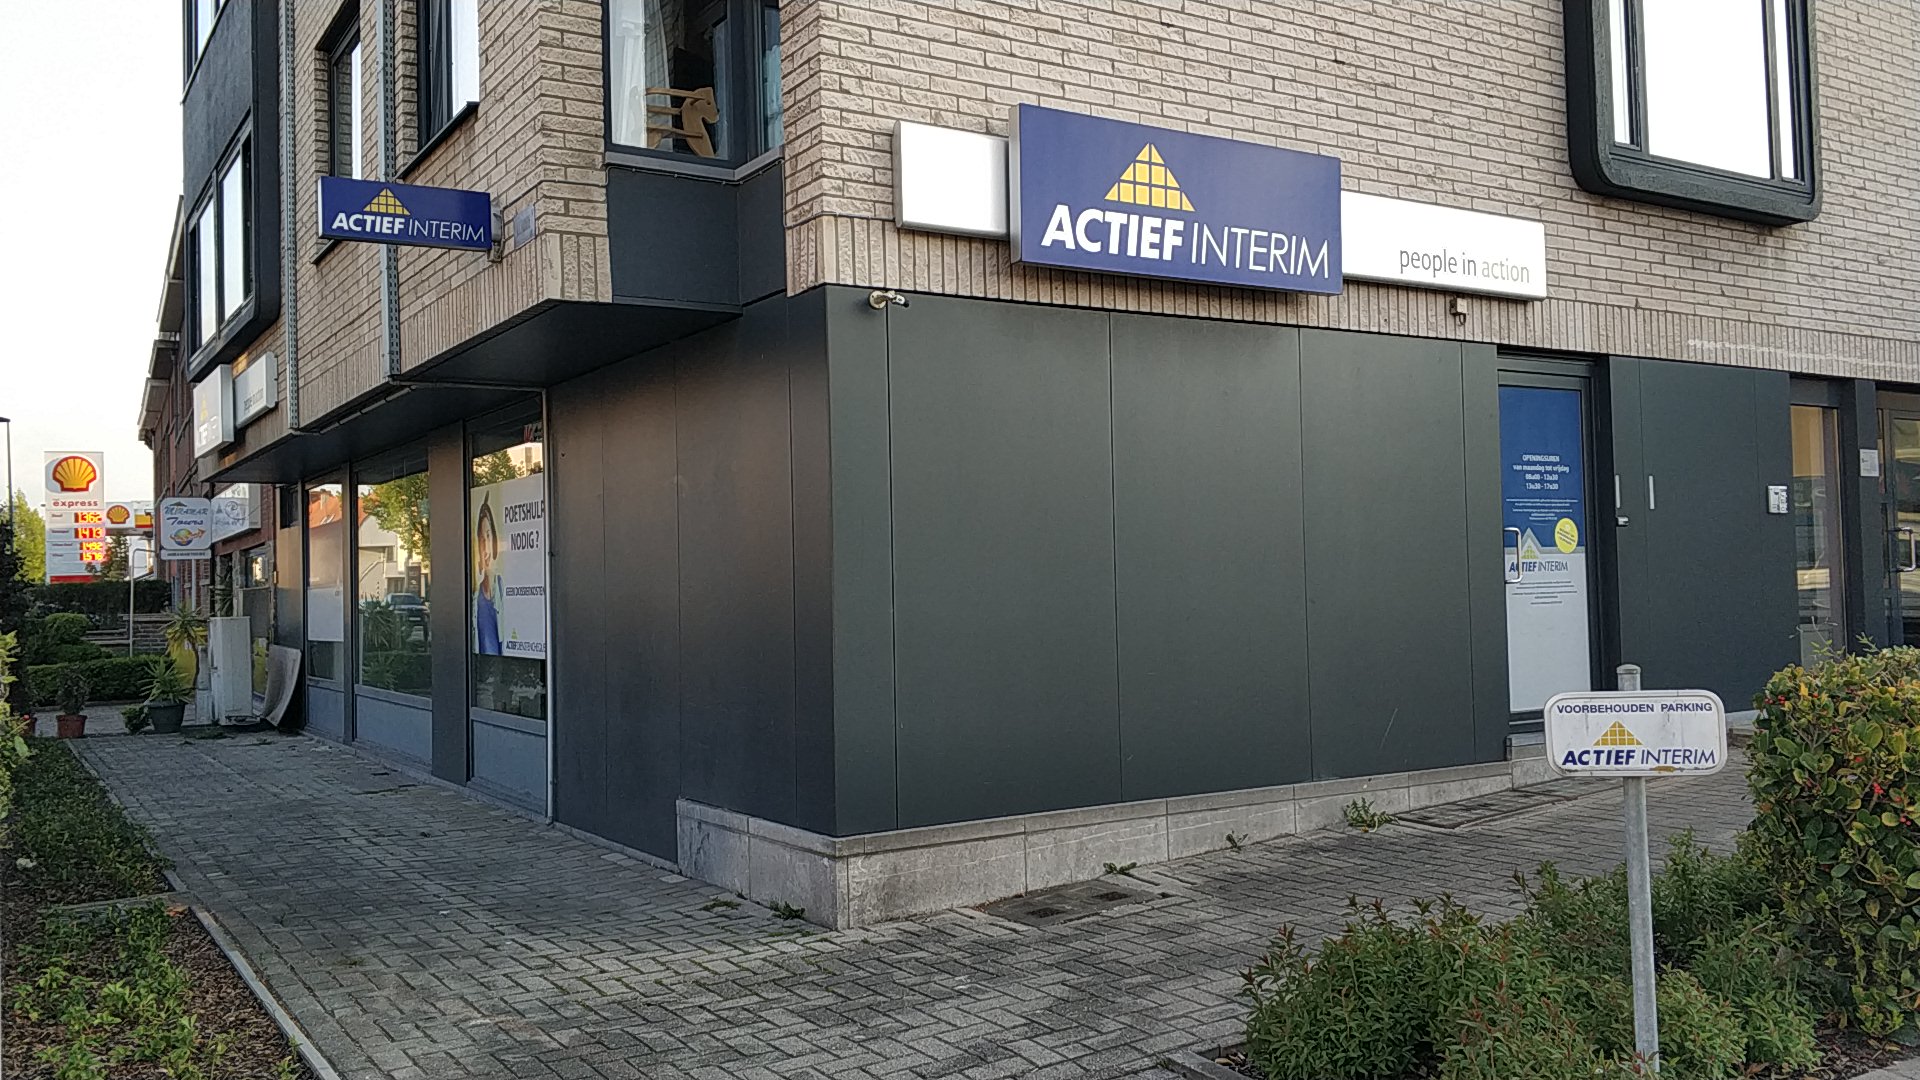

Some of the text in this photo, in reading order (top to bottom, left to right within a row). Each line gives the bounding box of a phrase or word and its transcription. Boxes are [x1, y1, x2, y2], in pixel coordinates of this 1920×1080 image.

[331, 212, 485, 242] ACTIEF INTERIM
[1040, 203, 1329, 279] ACTIEF INTERIM
[1400, 249, 1530, 284] people in action
[52, 500, 98, 508] express
[510, 532, 534, 551] NODIG
[1538, 560, 1568, 572] INTERIM
[1556, 702, 1713, 714] VOORBEHOUDEN PARKING
[1561, 748, 1716, 766] ACTIEF INTERIM
